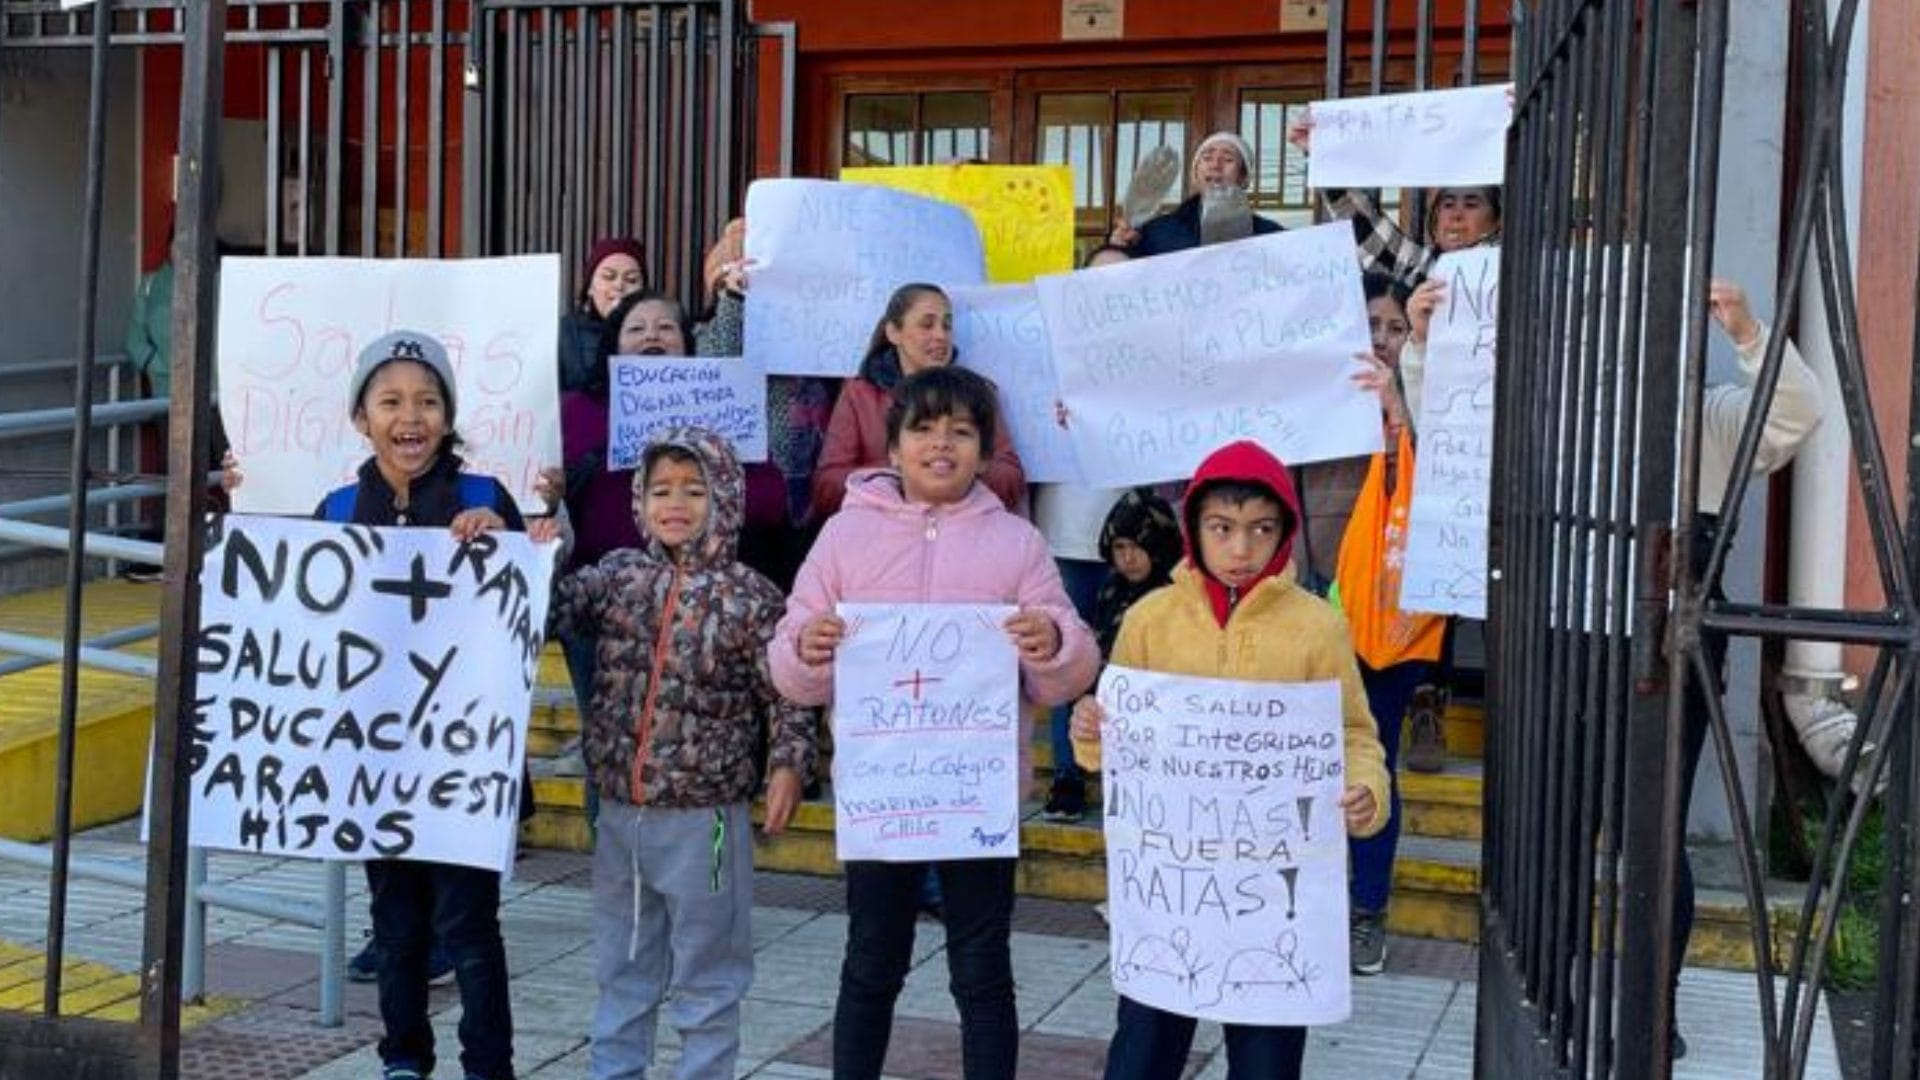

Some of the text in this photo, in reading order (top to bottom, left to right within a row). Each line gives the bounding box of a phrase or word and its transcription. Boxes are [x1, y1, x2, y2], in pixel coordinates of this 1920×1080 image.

[197, 623, 383, 693] SALUD
[1186, 693, 1286, 718] SALUD
[1140, 830, 1293, 862] FUERA
